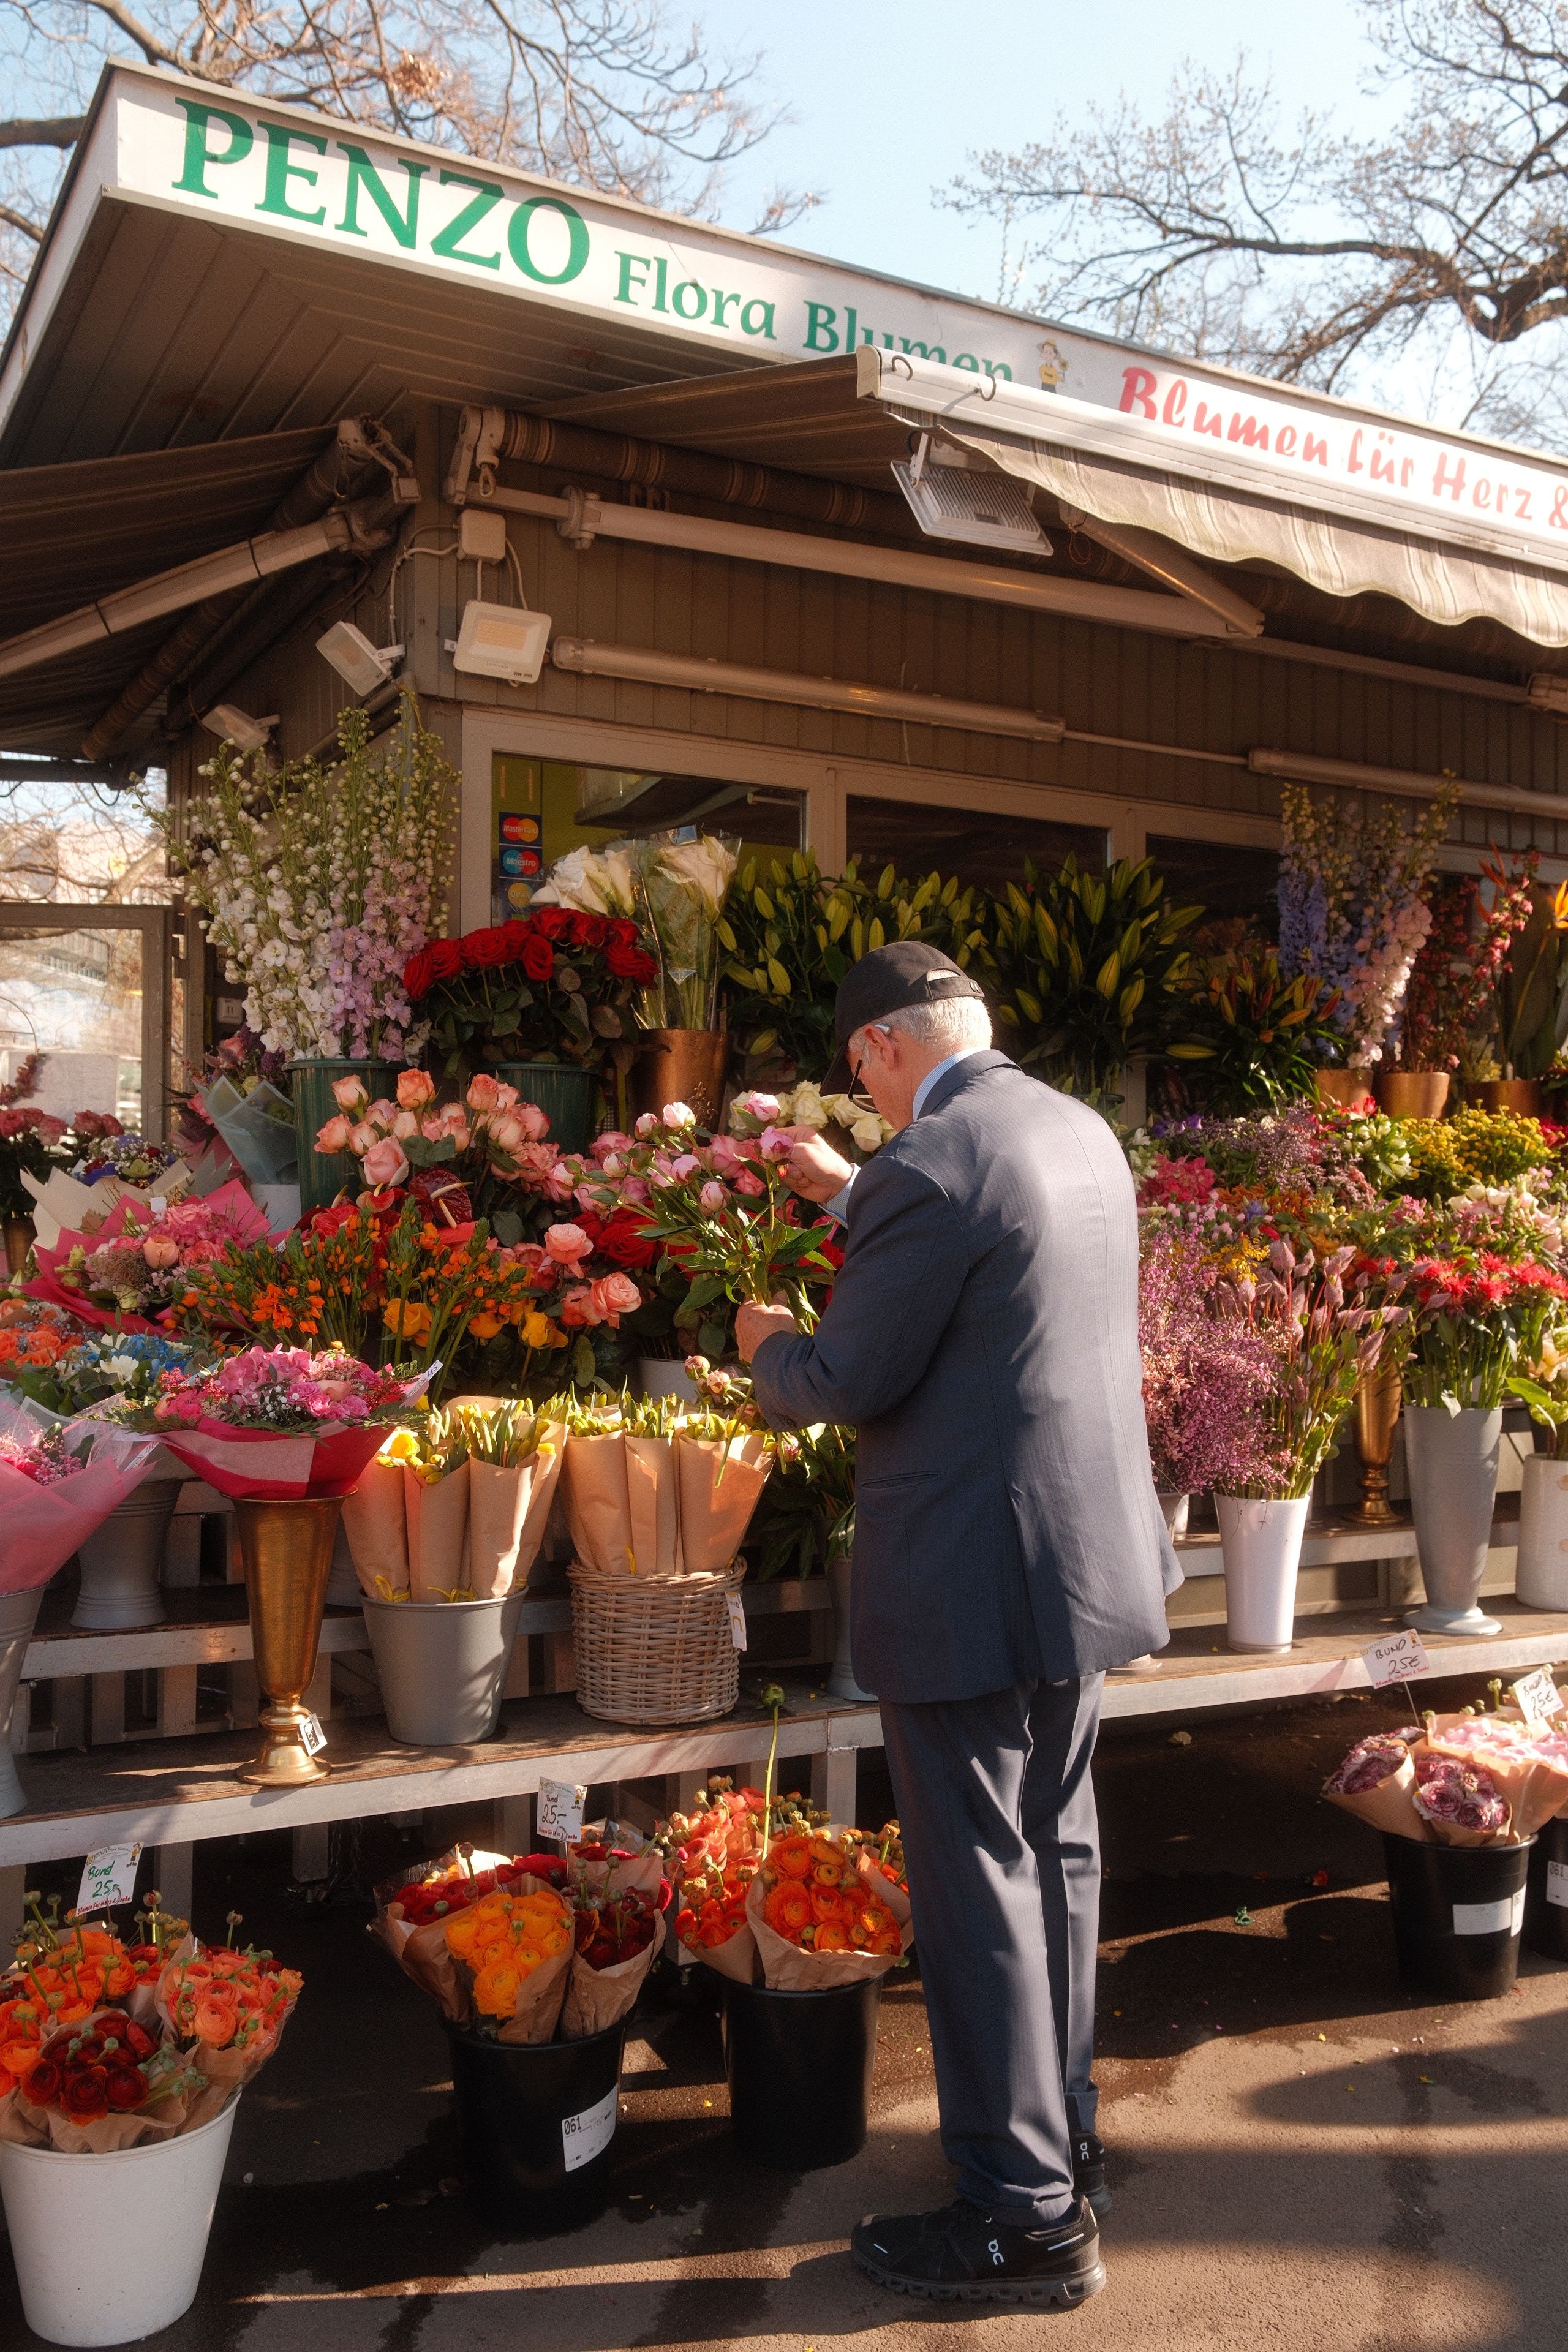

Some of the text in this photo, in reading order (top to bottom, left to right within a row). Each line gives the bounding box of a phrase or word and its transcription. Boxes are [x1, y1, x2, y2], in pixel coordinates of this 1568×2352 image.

[172, 97, 590, 285] PENZO
[613, 250, 777, 341] Flora
[1118, 366, 1568, 530] Blumen für Herz &
[506, 857, 537, 867] Maestro
[564, 2115, 582, 2135] 061
